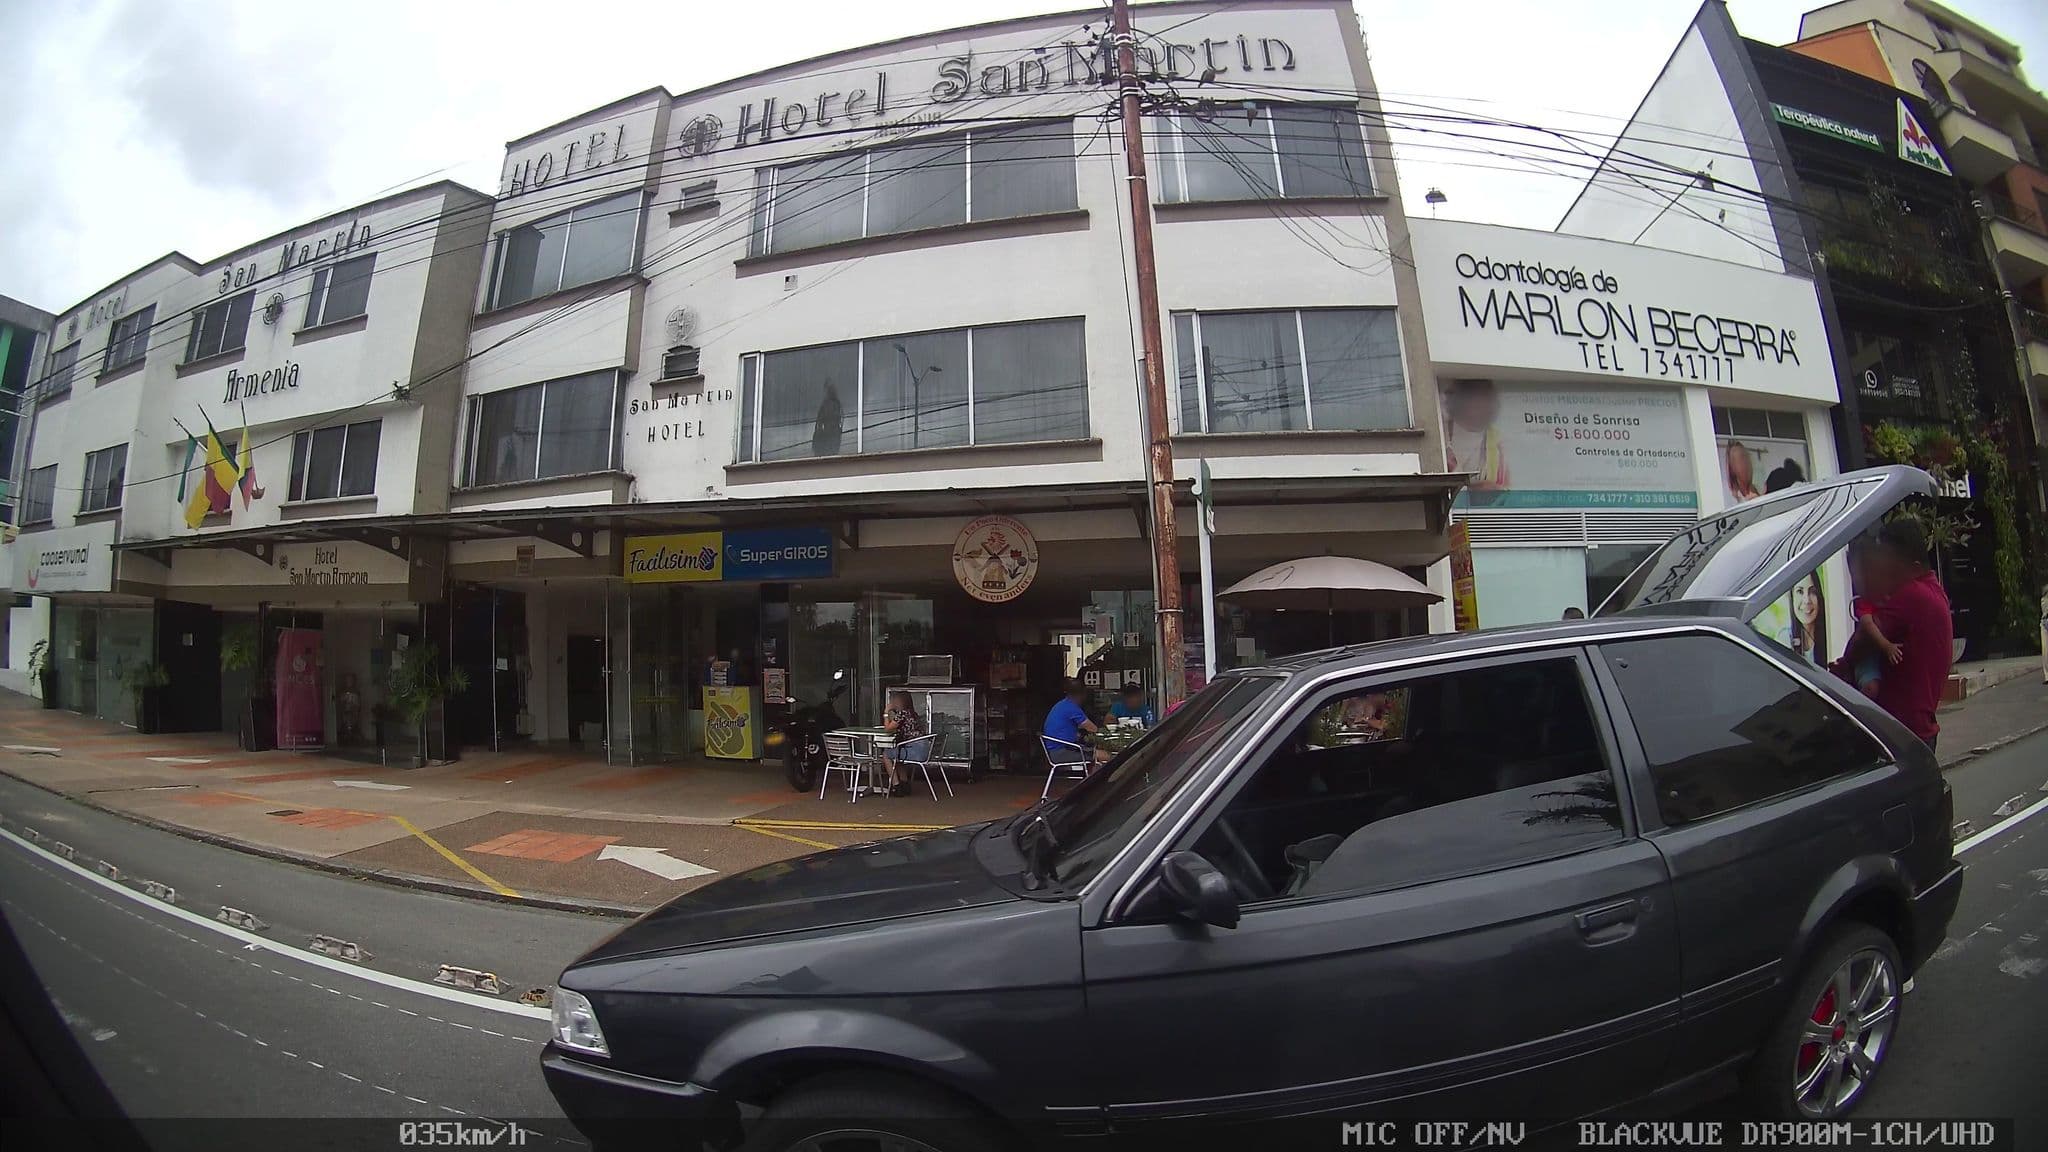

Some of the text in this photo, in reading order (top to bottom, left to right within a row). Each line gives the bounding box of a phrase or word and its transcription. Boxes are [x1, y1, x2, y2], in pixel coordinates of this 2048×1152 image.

[734, 71, 887, 148] Hotel
[930, 53, 1052, 104] San
[510, 124, 629, 198] HOTEL
[1455, 252, 1619, 294] Odontología de
[1458, 285, 1639, 345] MARLON
[1578, 342, 1735, 384] TEL 7341777
[223, 360, 300, 404] Armenia
[630, 389, 733, 415] San Martin
[648, 420, 705, 443] HOTEL
[1524, 411, 1641, 426] Diseño de Sonrisa
[1554, 427, 1631, 441] $1.600.000
[1574, 446, 1686, 459] Controles de Ortodoncia
[314, 546, 338, 565] Hotel
[332, 567, 369, 585] Armenia
